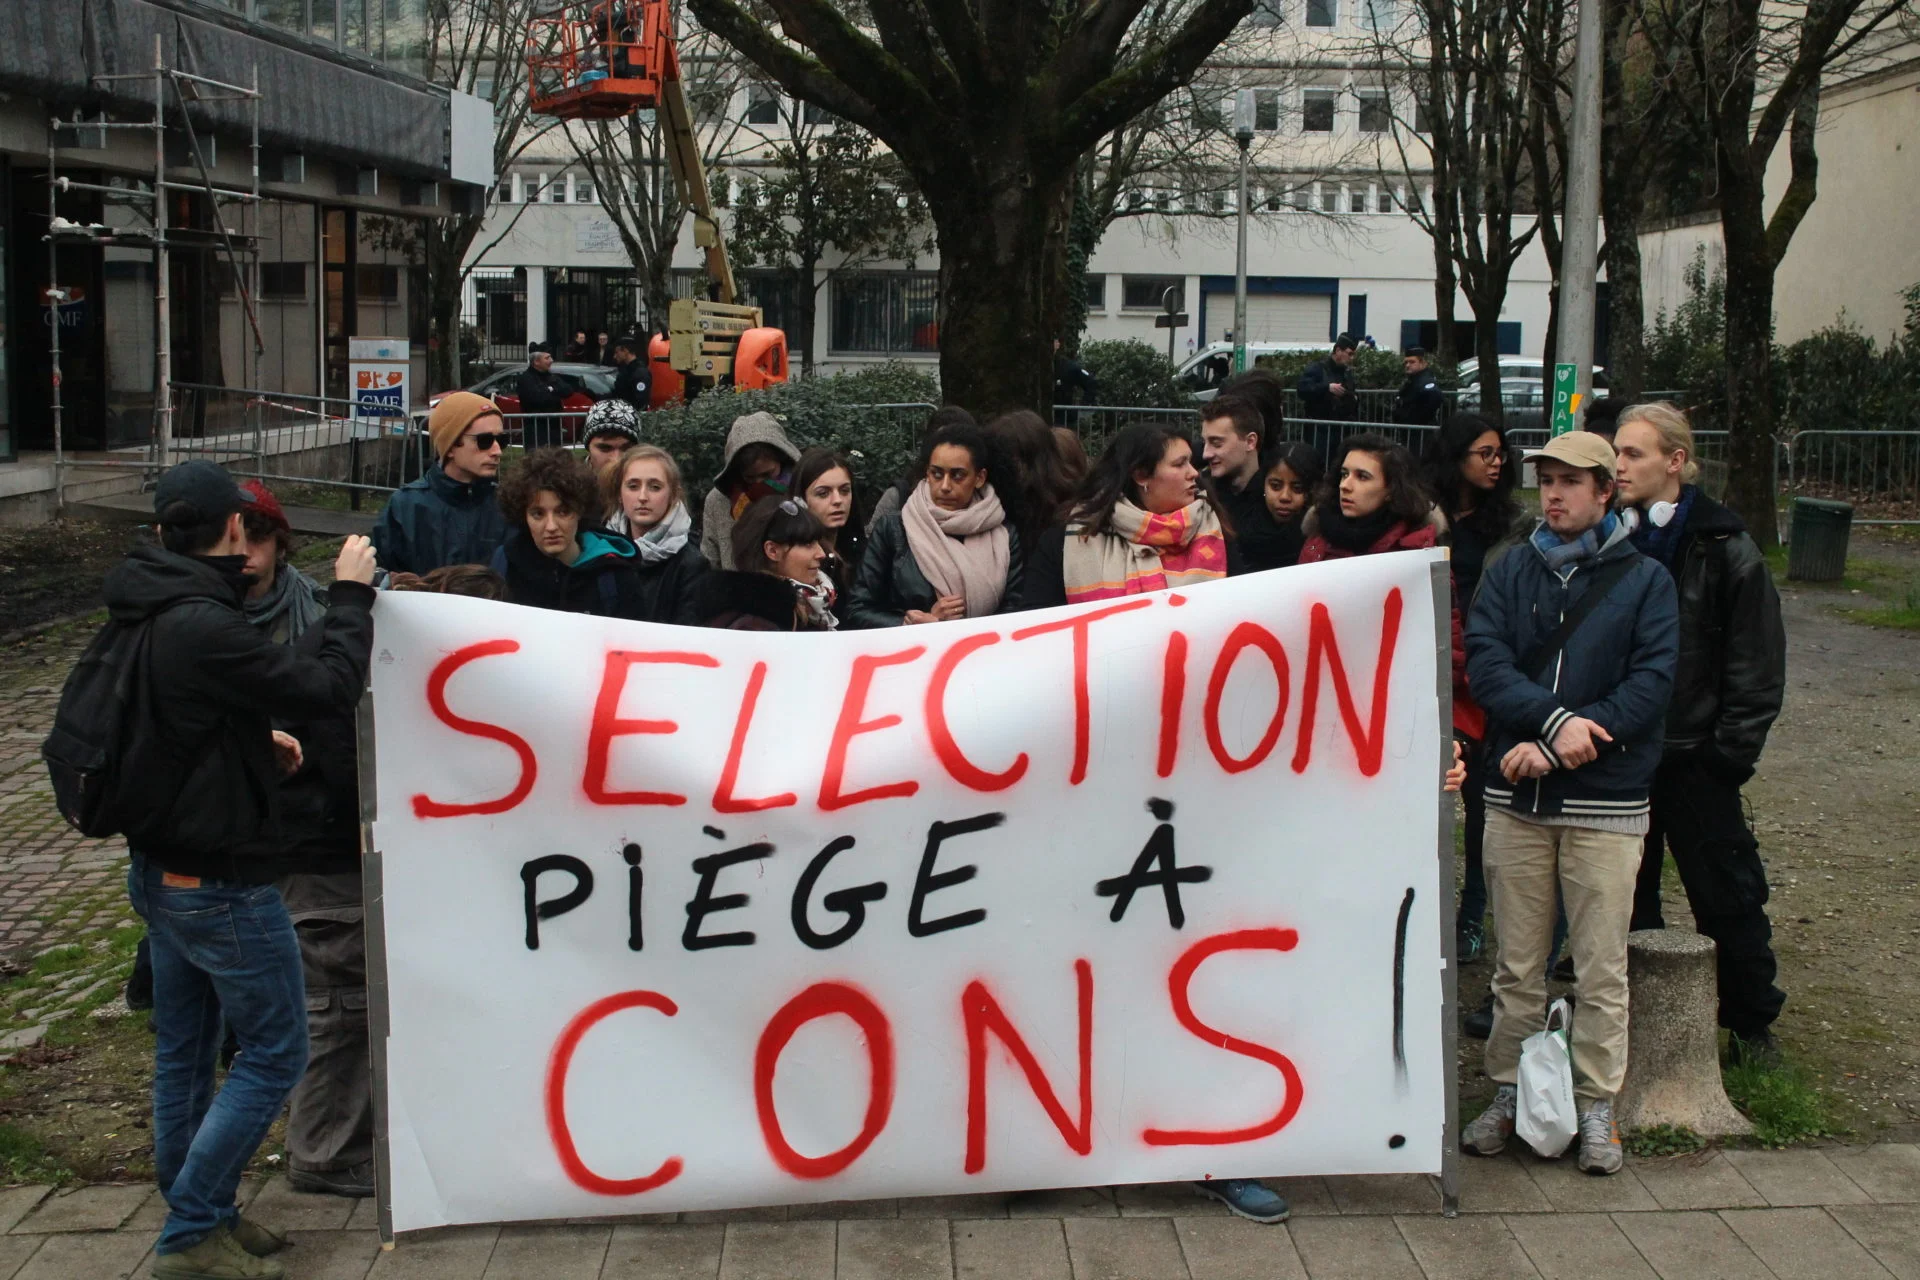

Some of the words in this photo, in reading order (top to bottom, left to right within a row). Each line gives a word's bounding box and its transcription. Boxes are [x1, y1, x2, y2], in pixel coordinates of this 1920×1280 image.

[361, 395, 400, 411] GMF
[1095, 797, 1213, 930] À
[547, 926, 1305, 1196] CONS
